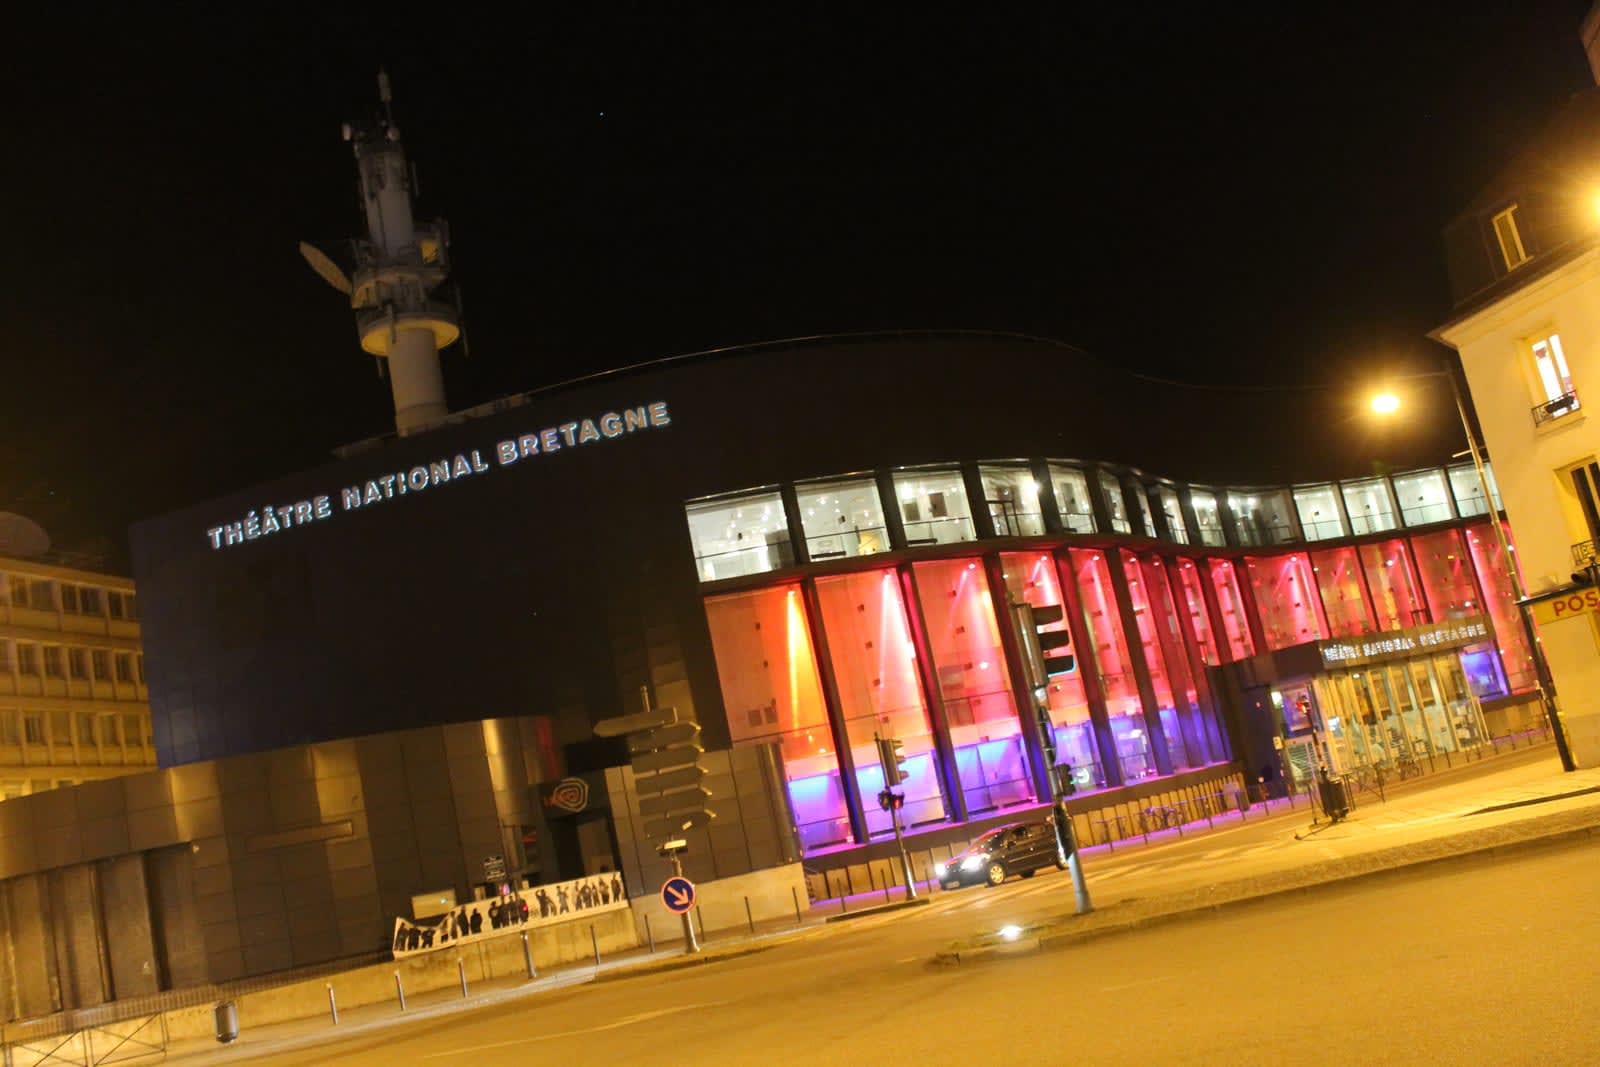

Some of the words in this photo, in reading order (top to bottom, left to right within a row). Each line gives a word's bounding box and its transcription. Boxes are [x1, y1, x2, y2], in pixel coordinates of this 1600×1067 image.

[207, 496, 332, 549] THÉÂTRE
[341, 450, 488, 511] NATIONAL
[496, 402, 671, 465] BRETAGNE
[1552, 590, 1600, 617] POS
